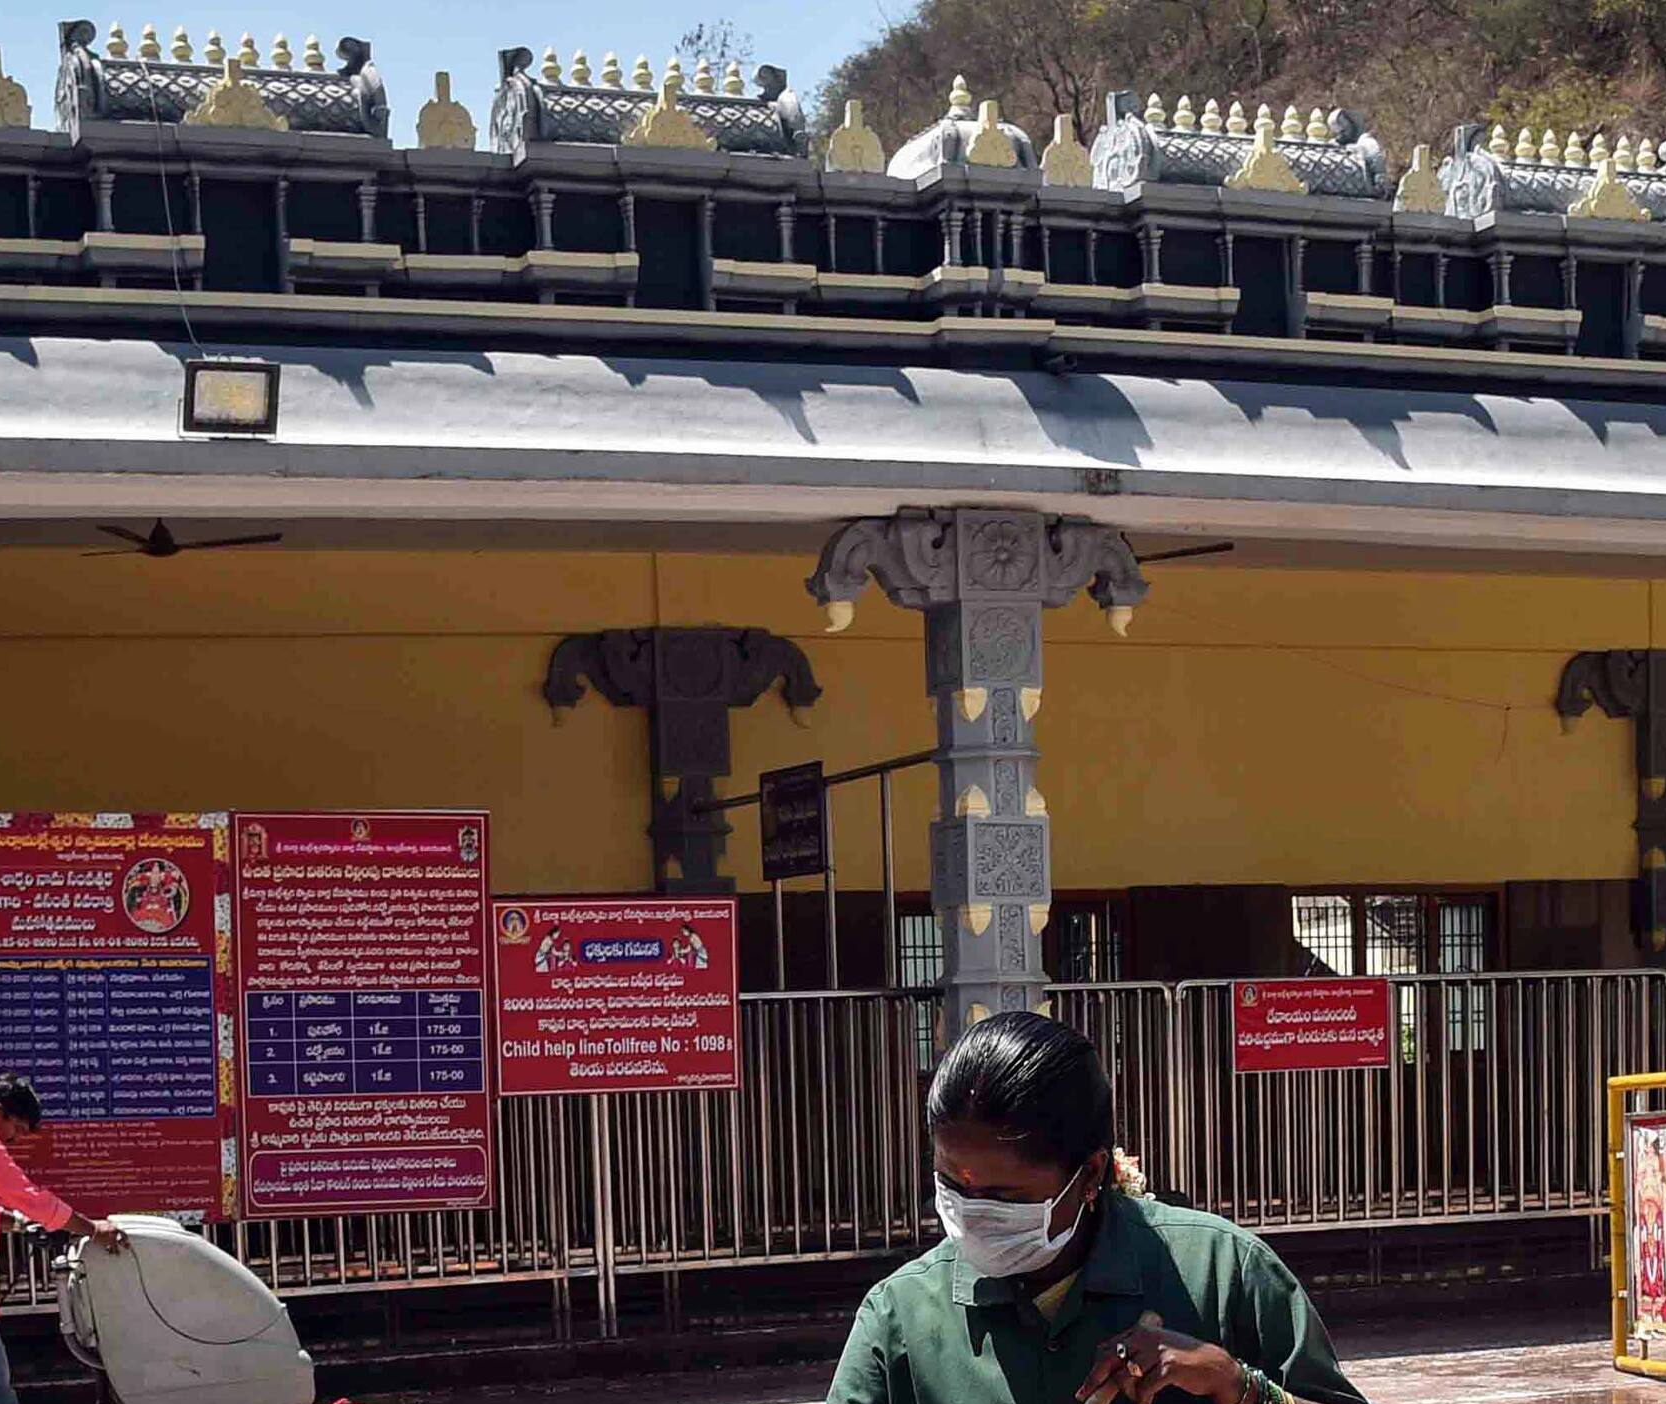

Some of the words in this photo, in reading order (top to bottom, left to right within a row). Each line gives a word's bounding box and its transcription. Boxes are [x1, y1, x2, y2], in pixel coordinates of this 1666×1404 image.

[426, 1024, 461, 1034] 175-00
[429, 1044, 465, 1055] 175-00
[502, 1039, 541, 1058] Child
[544, 1039, 576, 1060] help
[660, 1036, 681, 1053] No
[693, 1035, 725, 1052] 1098
[429, 1070, 465, 1081] 175-00
